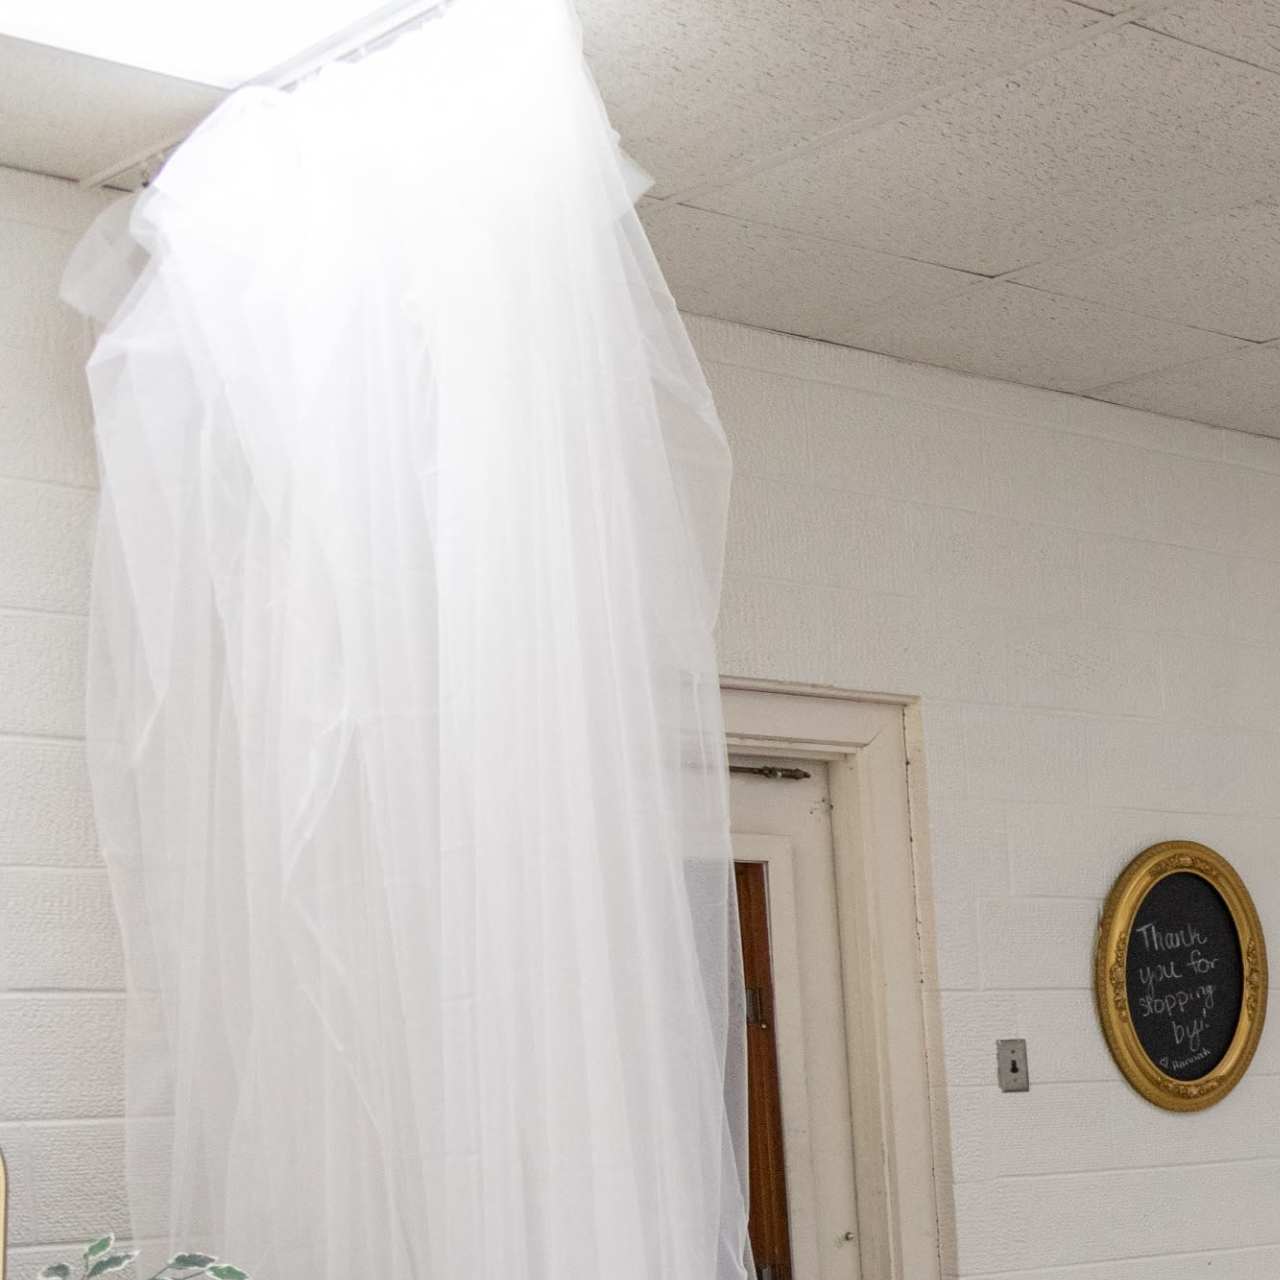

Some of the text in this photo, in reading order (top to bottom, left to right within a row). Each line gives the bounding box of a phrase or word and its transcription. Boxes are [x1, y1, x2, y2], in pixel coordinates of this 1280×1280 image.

[1136, 923, 1208, 950] Thank
[1139, 949, 1219, 997] you for
